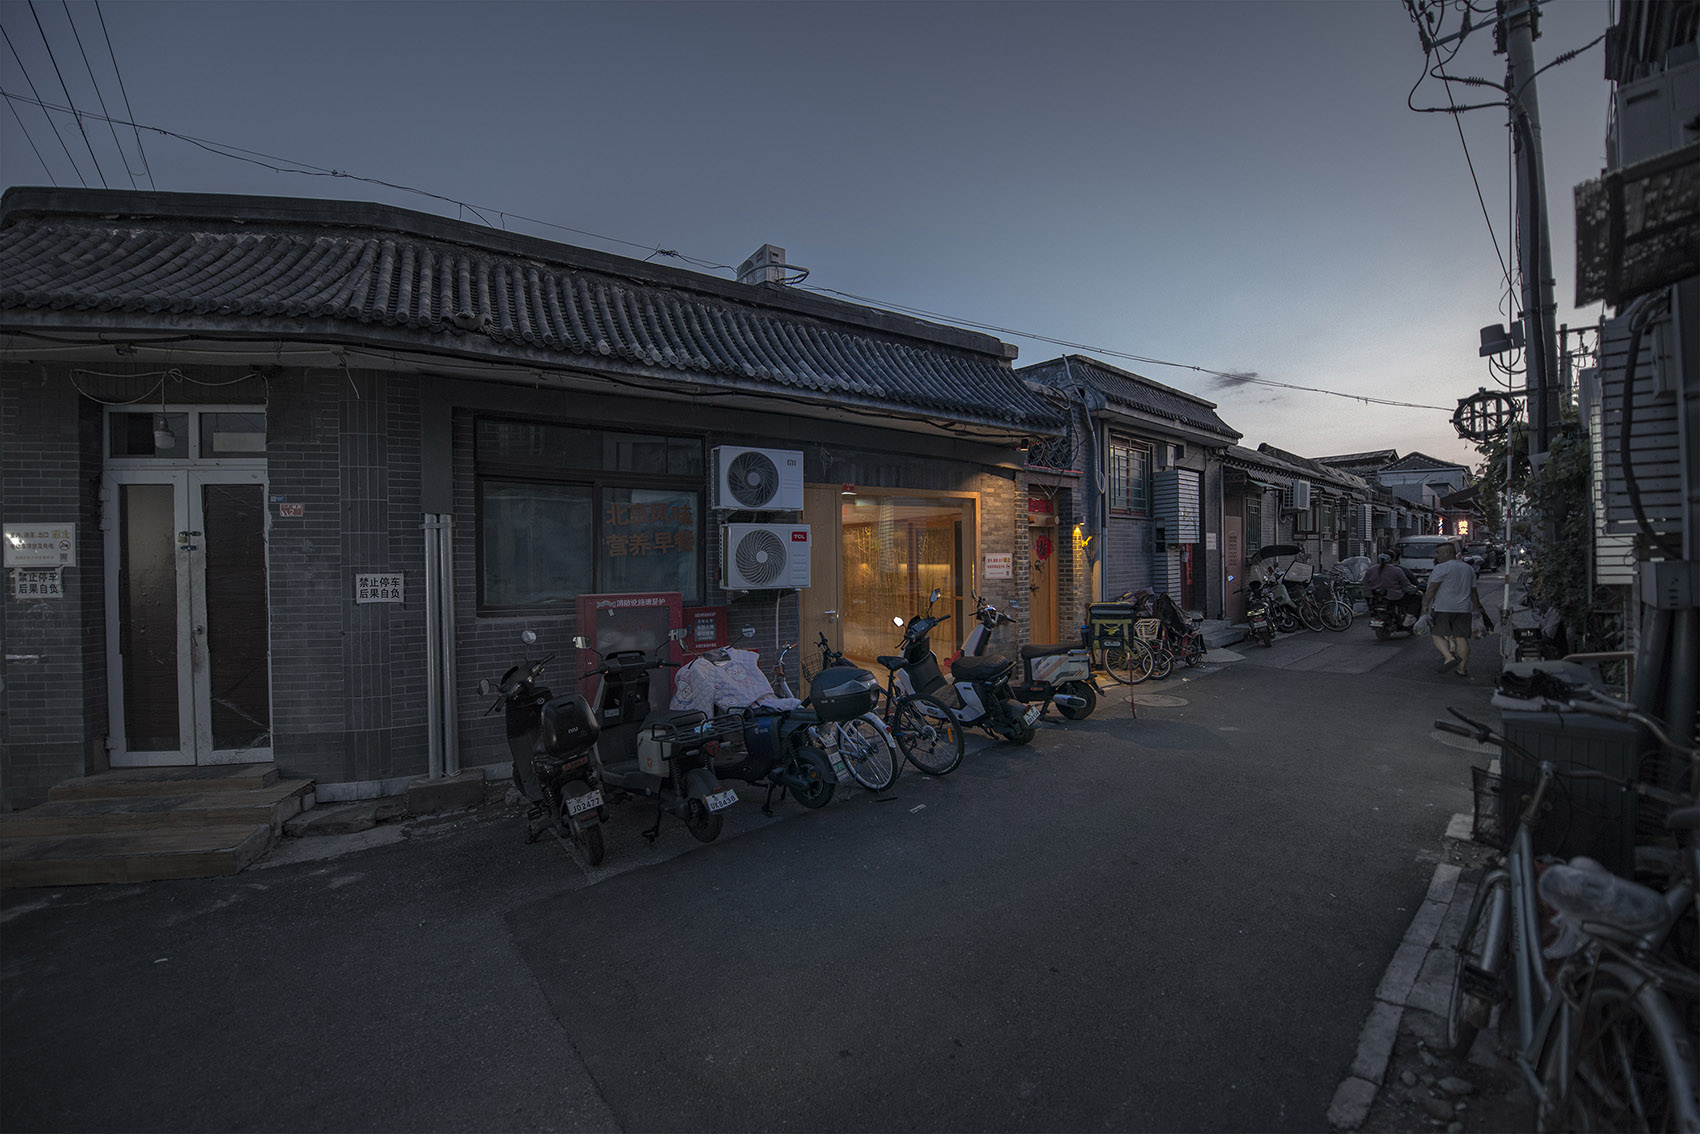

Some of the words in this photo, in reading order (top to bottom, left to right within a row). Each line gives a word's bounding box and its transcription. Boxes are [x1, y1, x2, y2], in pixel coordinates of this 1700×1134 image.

[605, 502, 693, 526] 北京风味
[605, 530, 694, 558] 营养早餐
[18, 572, 58, 583] 禁止停车
[359, 577, 400, 587] 禁止停车
[18, 583, 59, 594] 后果自负
[359, 588, 400, 599] 后果自负
[572, 797, 600, 814] J02477
